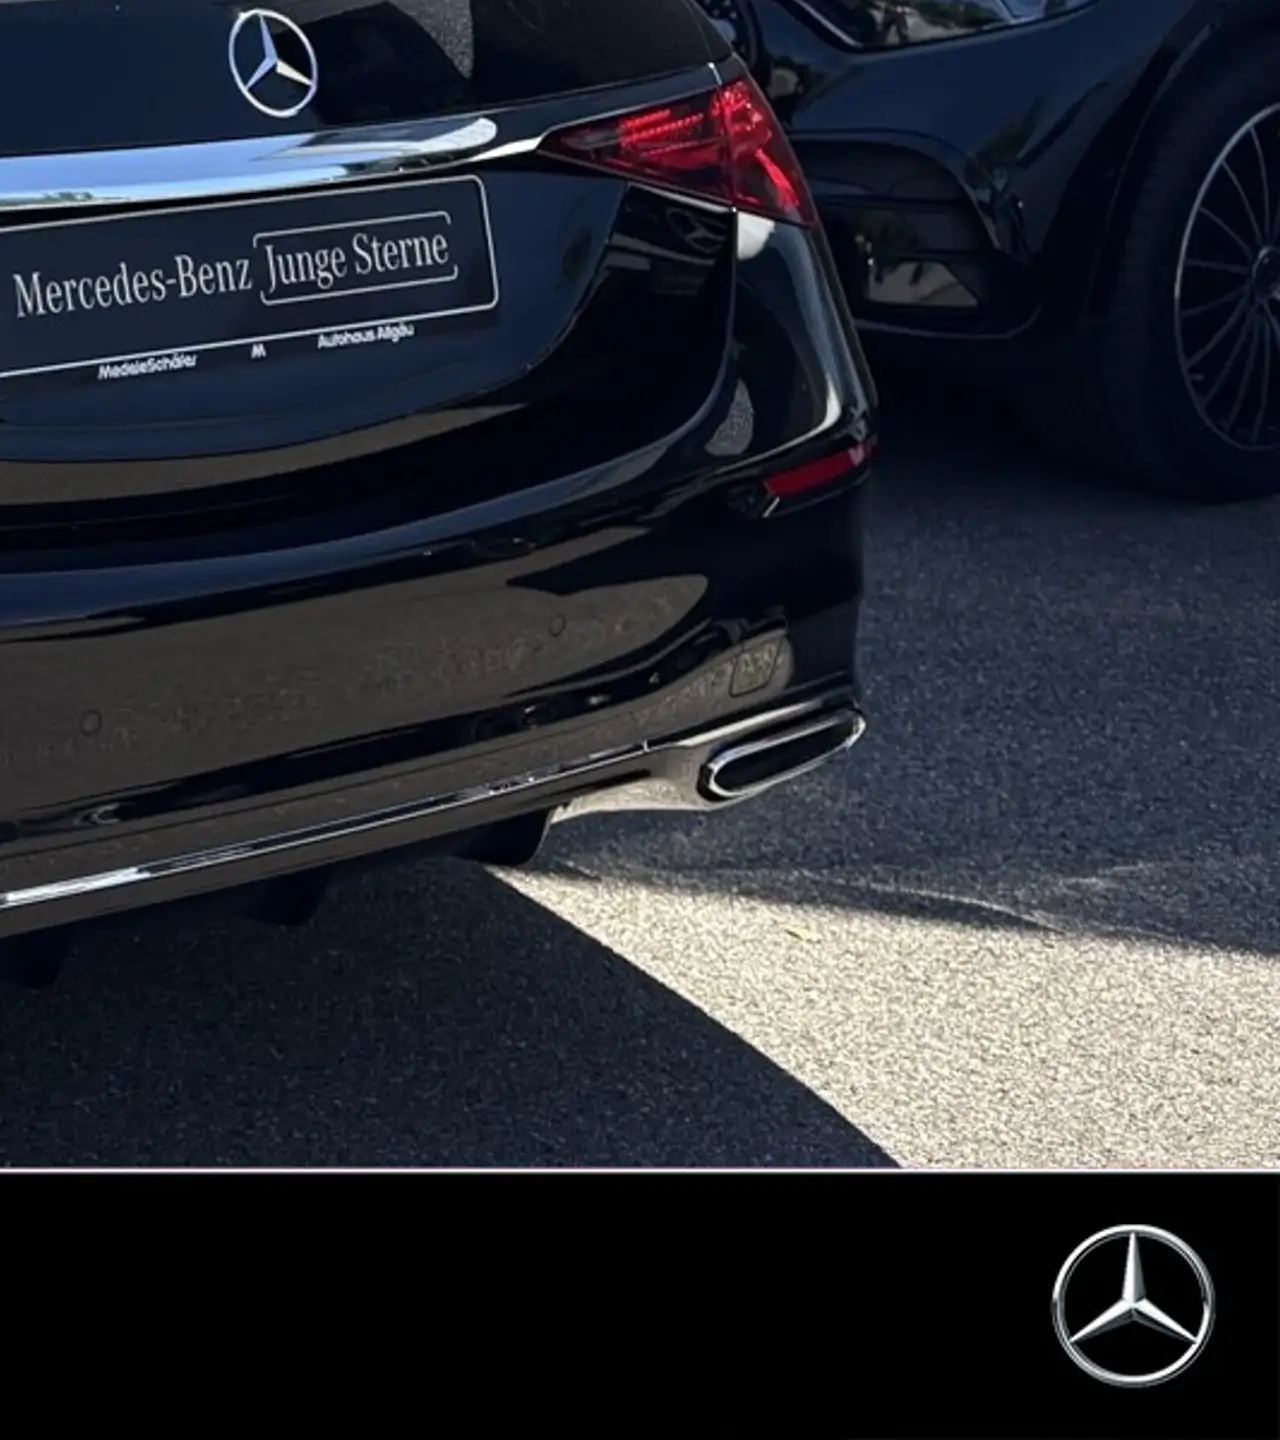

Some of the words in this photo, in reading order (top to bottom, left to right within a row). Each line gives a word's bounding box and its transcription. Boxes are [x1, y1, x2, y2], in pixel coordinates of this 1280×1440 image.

[13, 252, 253, 318] Mercedes-Benz
[264, 242, 347, 294] Junge
[351, 231, 449, 275] Sterne
[316, 327, 376, 350] Autohaus
